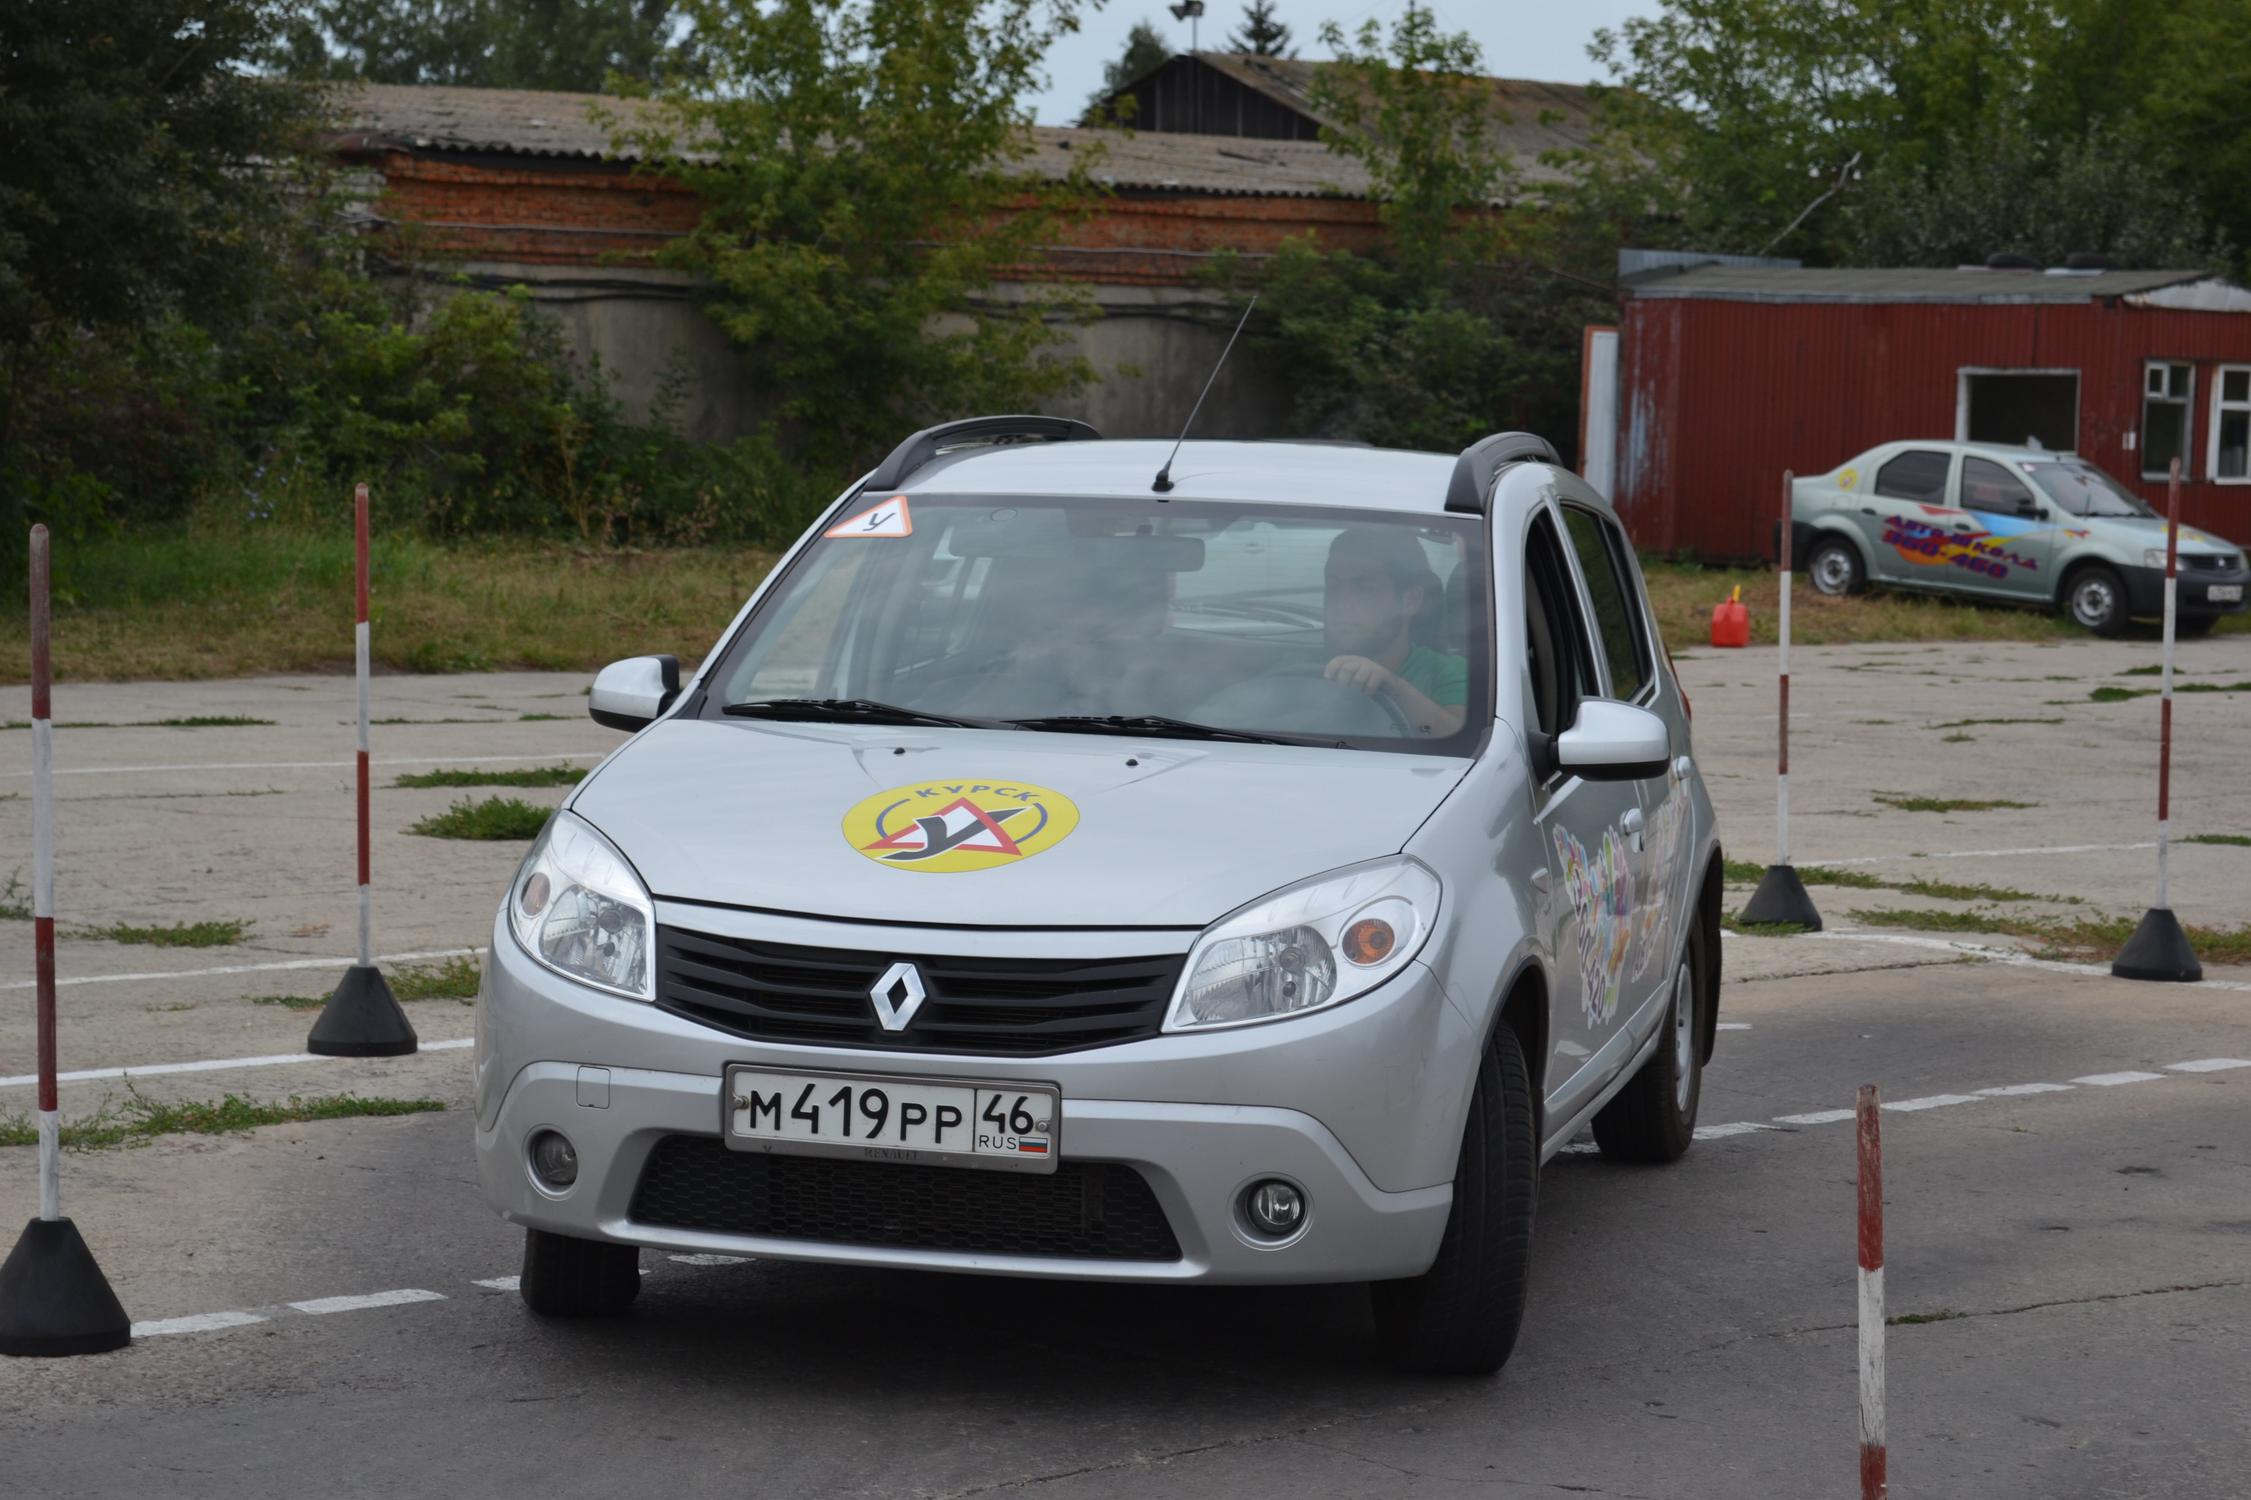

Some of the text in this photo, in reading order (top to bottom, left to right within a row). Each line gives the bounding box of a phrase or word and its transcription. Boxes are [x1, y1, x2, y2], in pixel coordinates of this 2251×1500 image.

[862, 512, 896, 532] У
[915, 784, 1040, 803] КУРСК
[749, 1083, 1035, 1144] М419РР 46
[978, 1134, 1017, 1150] RUS
